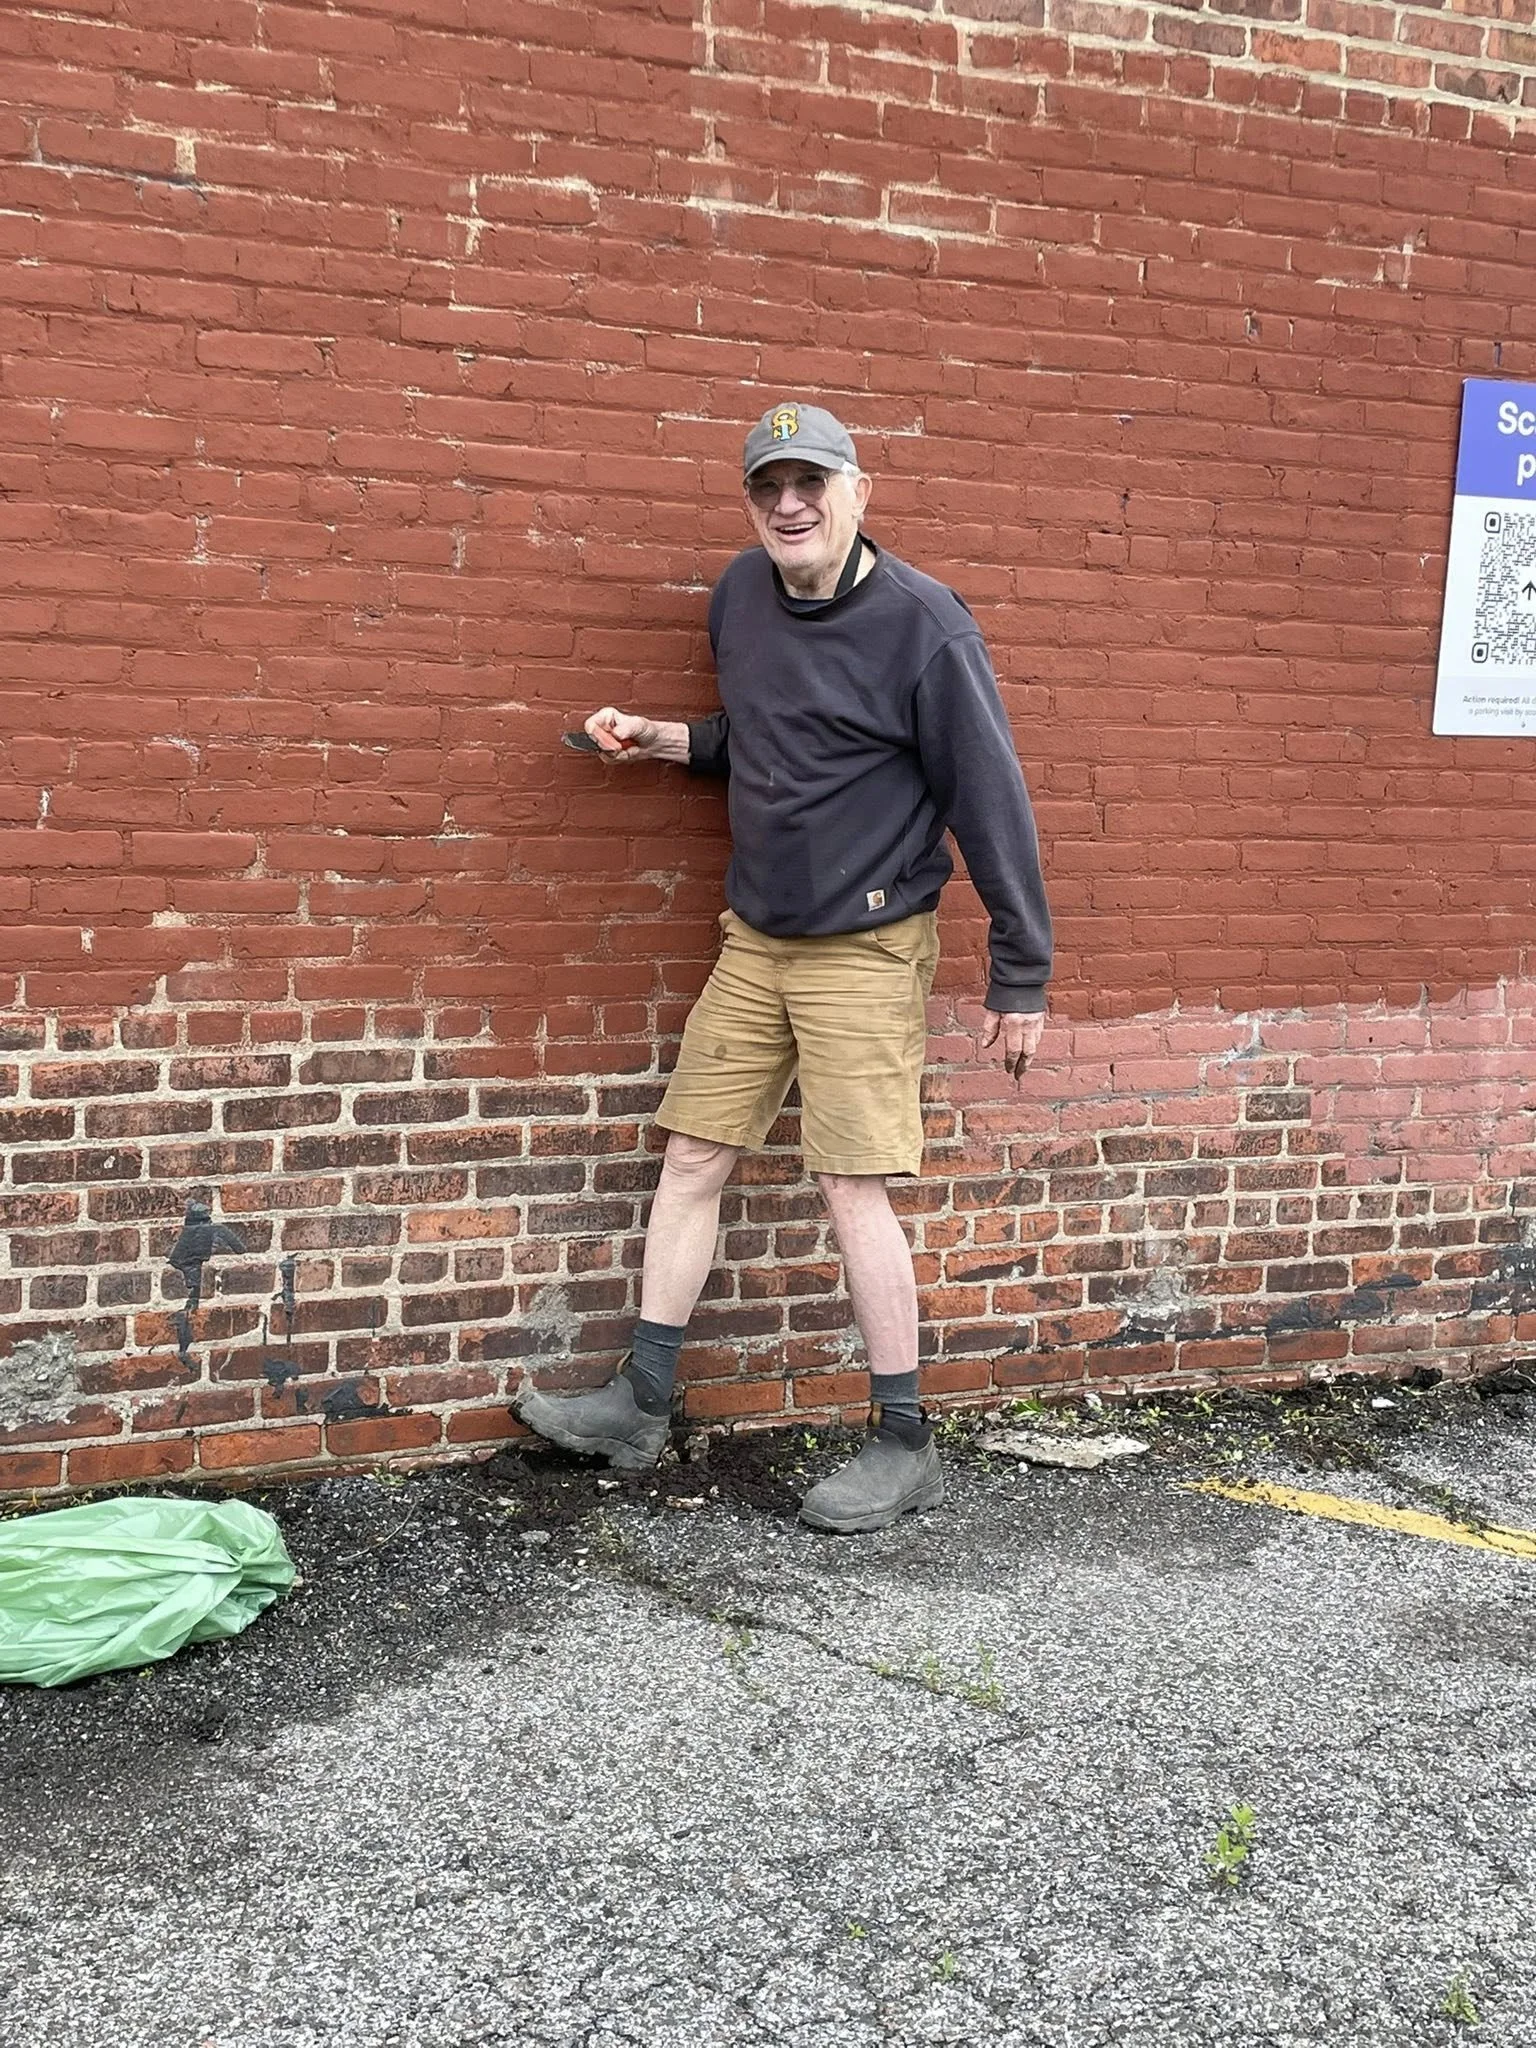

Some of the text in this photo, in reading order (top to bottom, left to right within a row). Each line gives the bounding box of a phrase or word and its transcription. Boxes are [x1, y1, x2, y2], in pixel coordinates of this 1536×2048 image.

[1497, 401, 1536, 436] Sc
[1463, 695, 1486, 703] Action
[1474, 708, 1500, 717] parking
